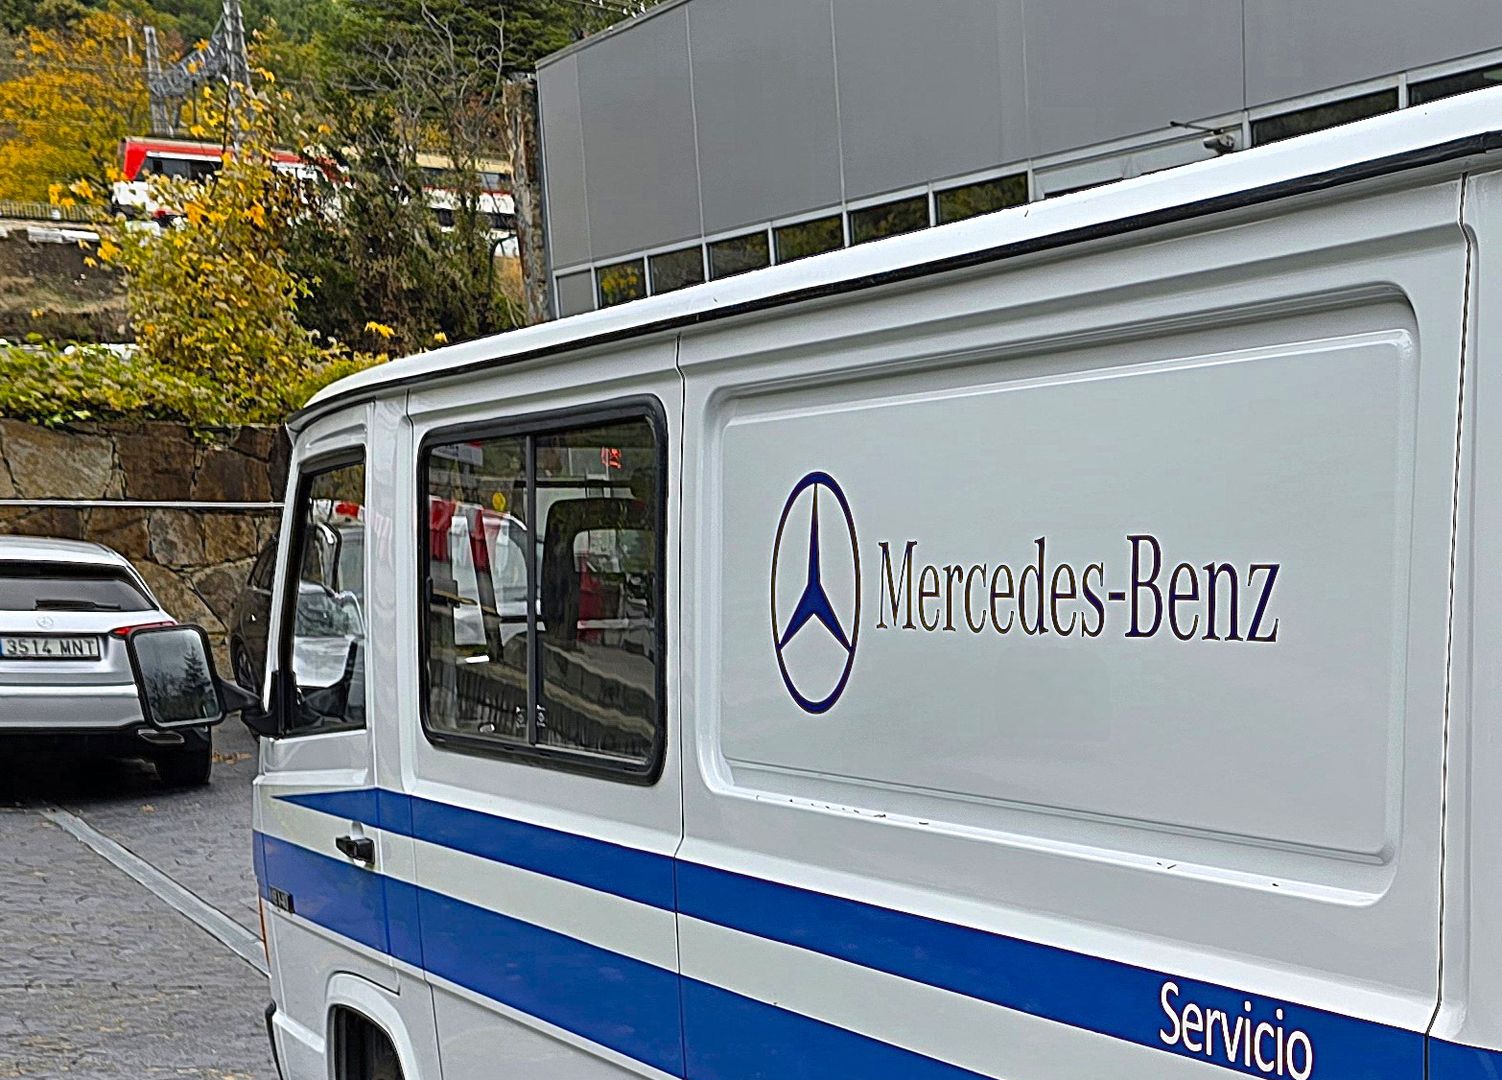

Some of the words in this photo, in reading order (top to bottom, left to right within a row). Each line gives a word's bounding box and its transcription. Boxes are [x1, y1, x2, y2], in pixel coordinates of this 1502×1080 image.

[876, 533, 1281, 643] Mercedes-Benz
[6, 638, 52, 655] 3514
[60, 639, 95, 656] MNT
